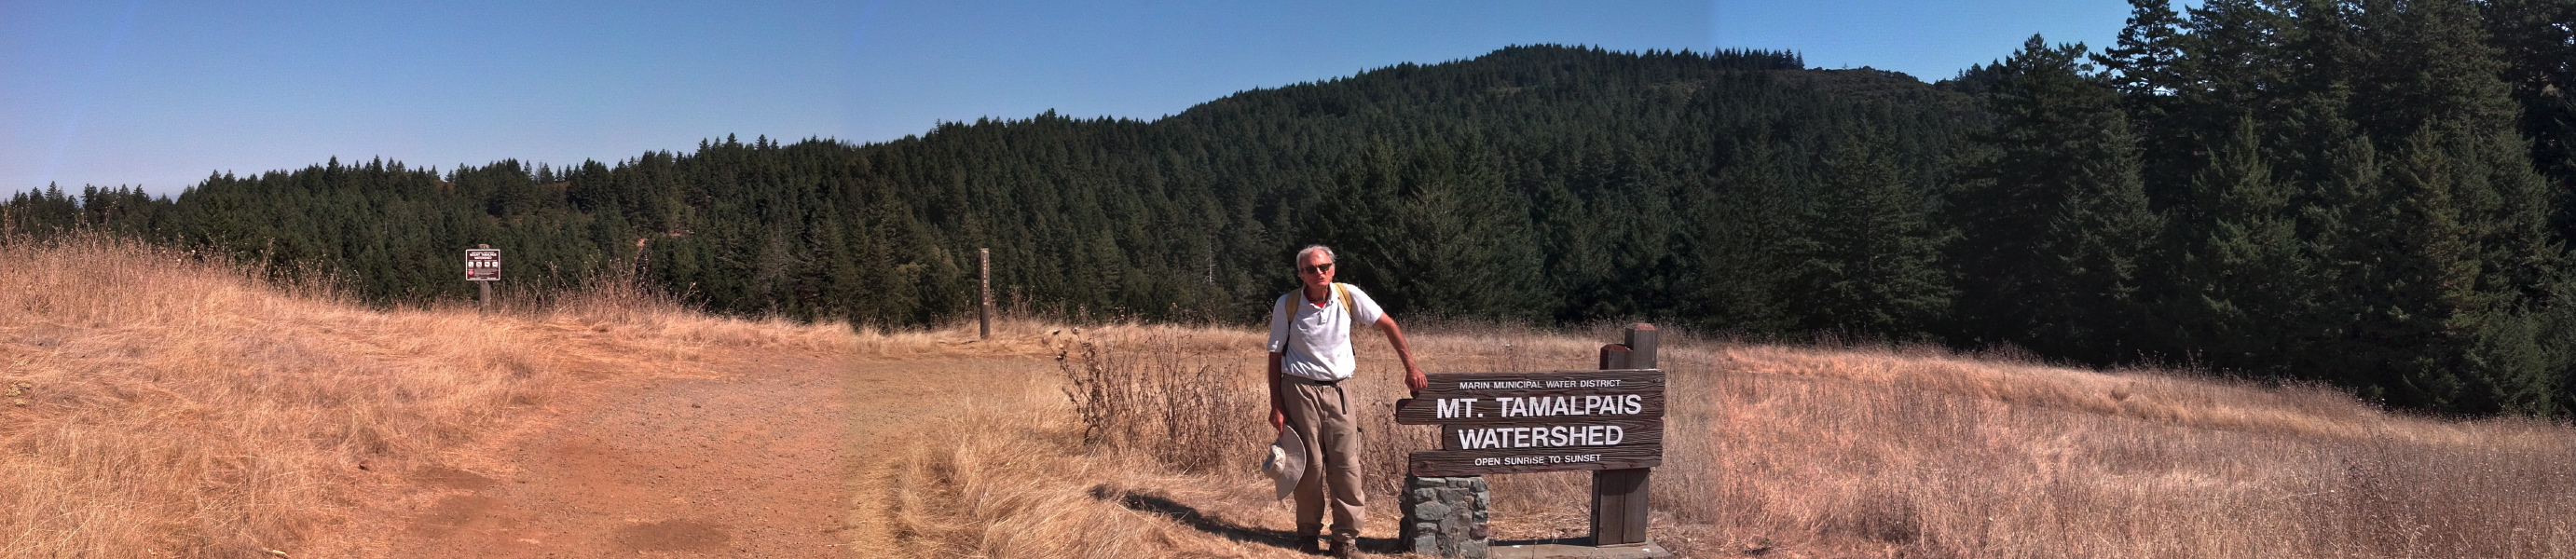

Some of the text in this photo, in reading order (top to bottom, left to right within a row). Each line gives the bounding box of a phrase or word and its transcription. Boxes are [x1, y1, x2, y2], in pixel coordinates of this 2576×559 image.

[1494, 381, 1542, 389] MUNICIPAL
[1580, 379, 1621, 388] DISTRICT
[1436, 395, 1642, 419] MT. TAMALPAIS
[1458, 425, 1624, 450] WATERSHED
[1474, 454, 1602, 466] OPEN SUNRISE TO SUNSET
